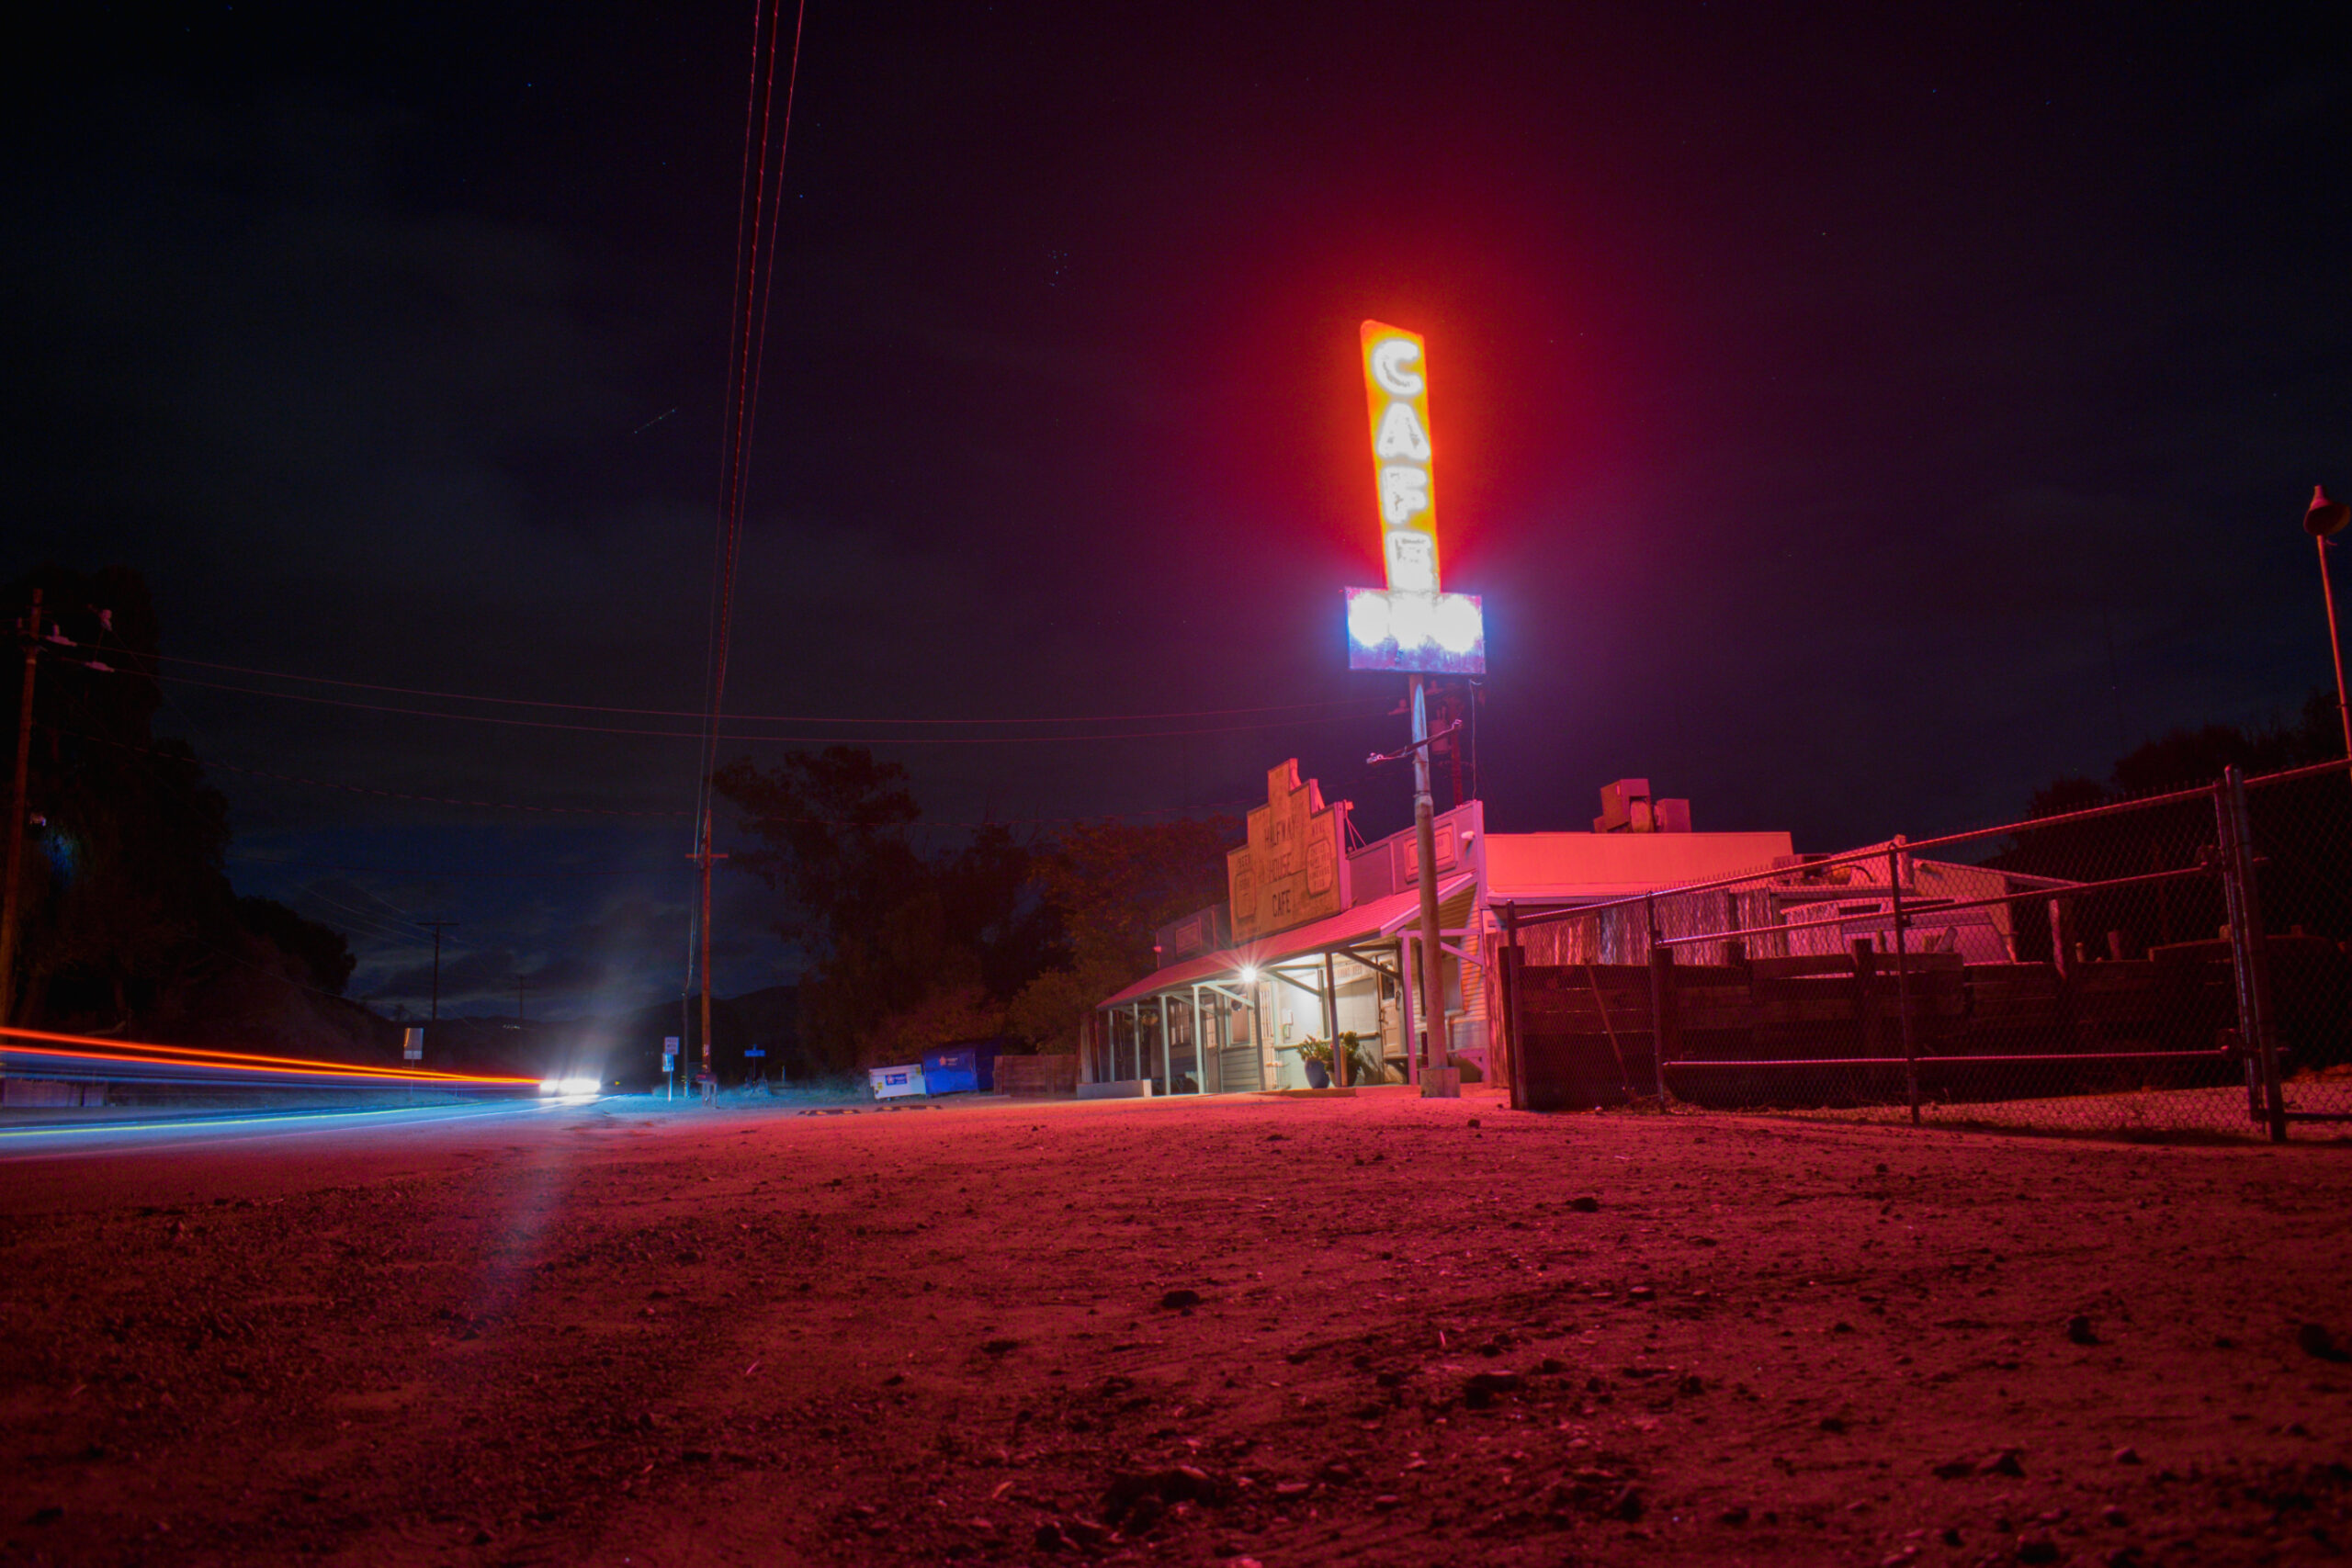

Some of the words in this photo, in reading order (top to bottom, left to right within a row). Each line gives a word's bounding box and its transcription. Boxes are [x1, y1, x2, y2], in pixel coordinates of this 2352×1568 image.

[1371, 337, 1434, 590] CAFE
[1264, 814, 1296, 850] HALFWAY
[1268, 852, 1292, 882] HOUSE
[1272, 889, 1291, 918] CAFE
